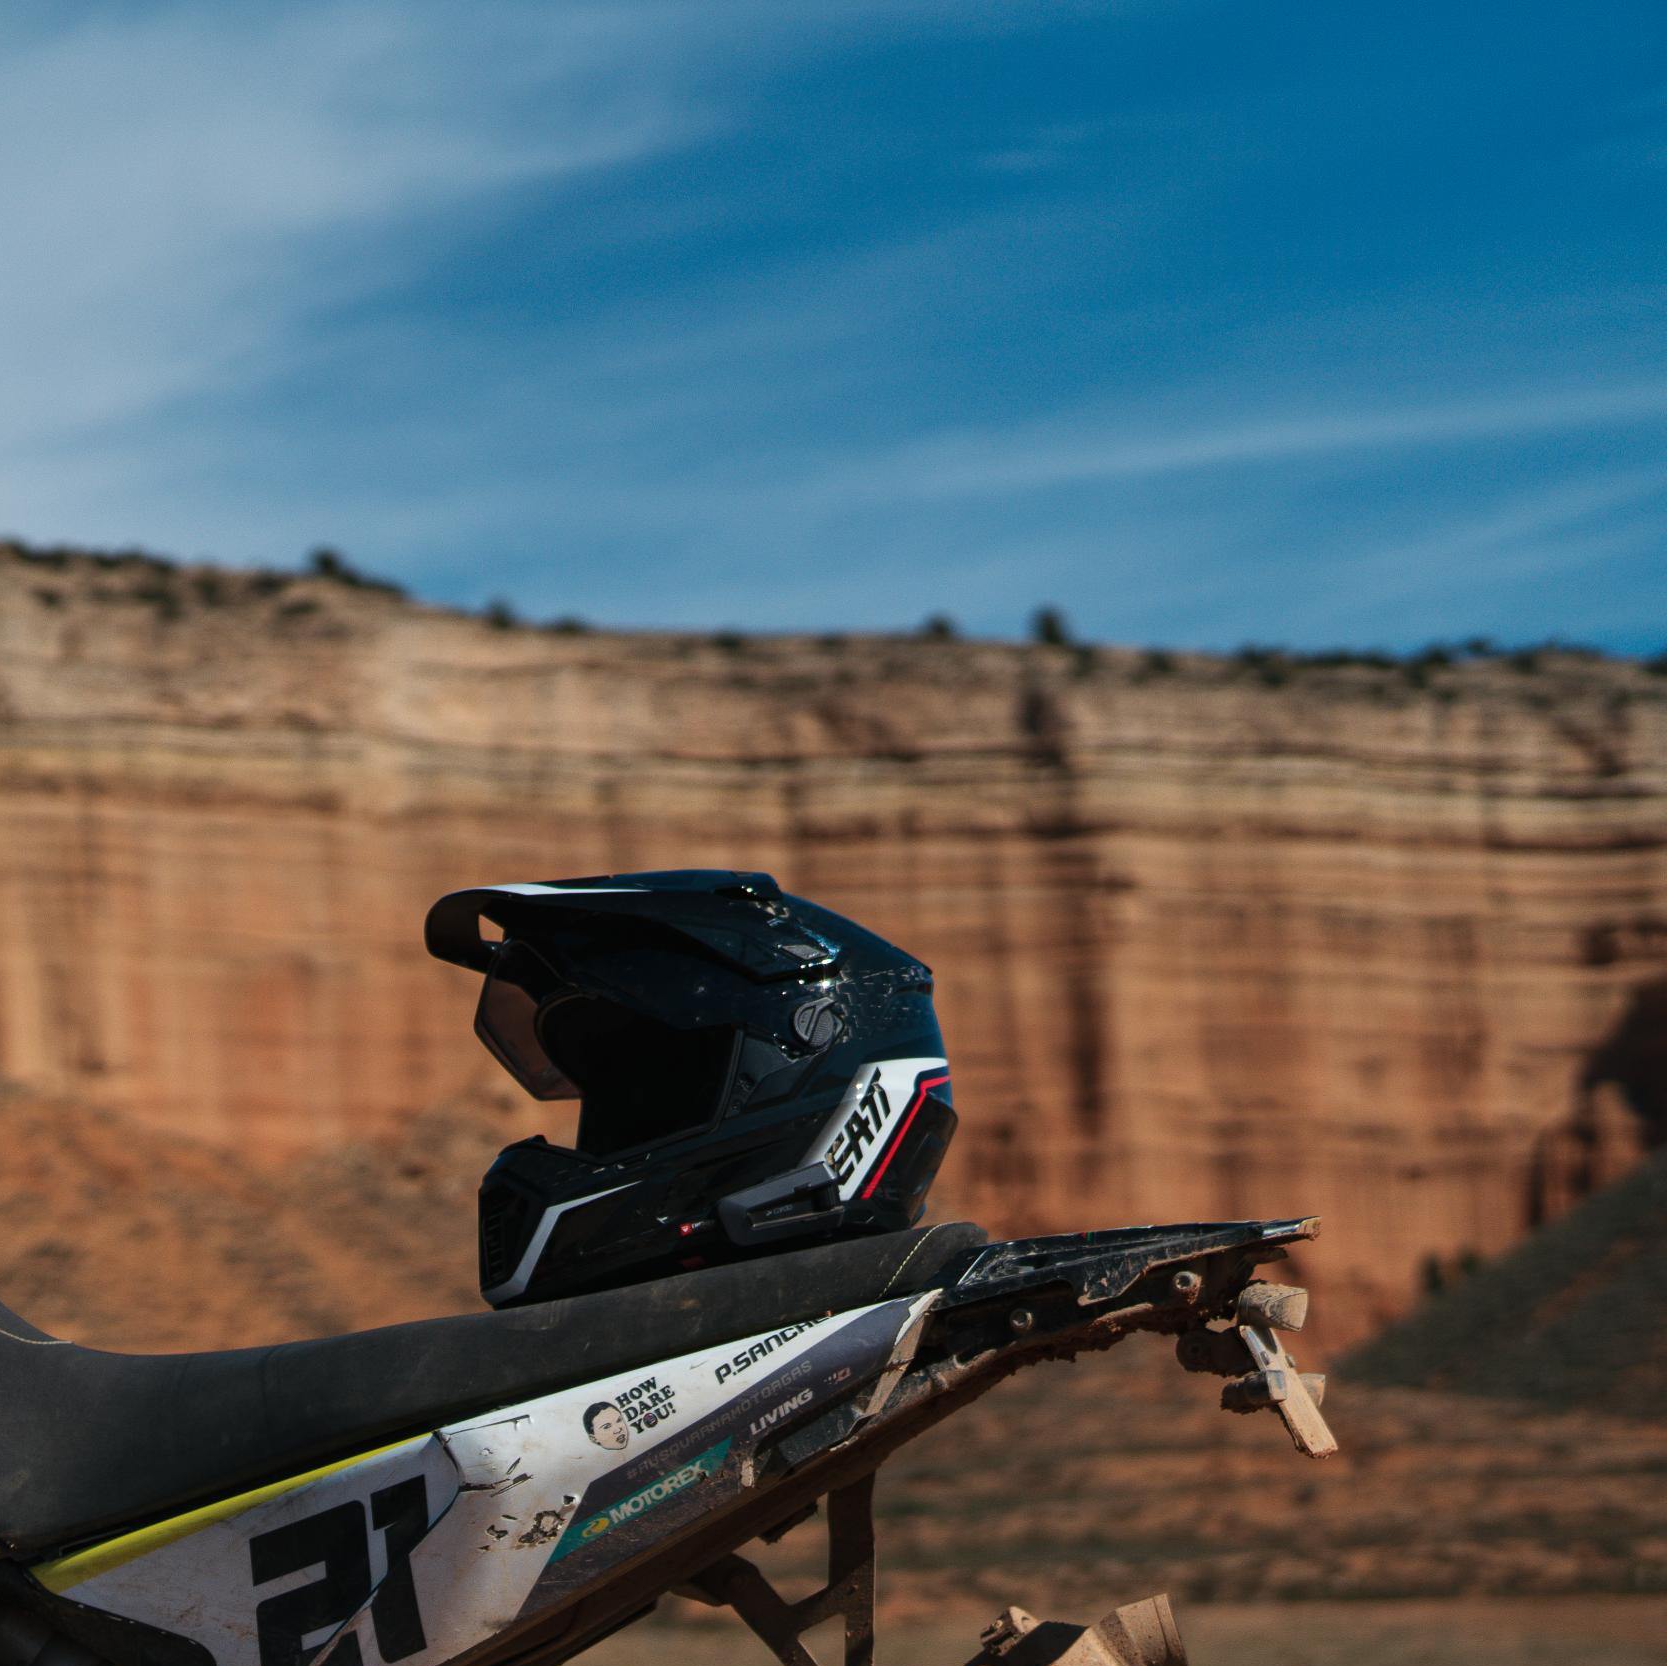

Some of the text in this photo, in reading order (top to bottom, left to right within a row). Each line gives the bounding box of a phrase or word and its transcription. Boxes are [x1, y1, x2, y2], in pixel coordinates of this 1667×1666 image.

[615, 1376, 657, 1408] HOW
[623, 1385, 675, 1422] DARE
[630, 1402, 676, 1434] YOU!
[749, 1388, 814, 1436] LIVING
[609, 1459, 710, 1525] MOTOREX
